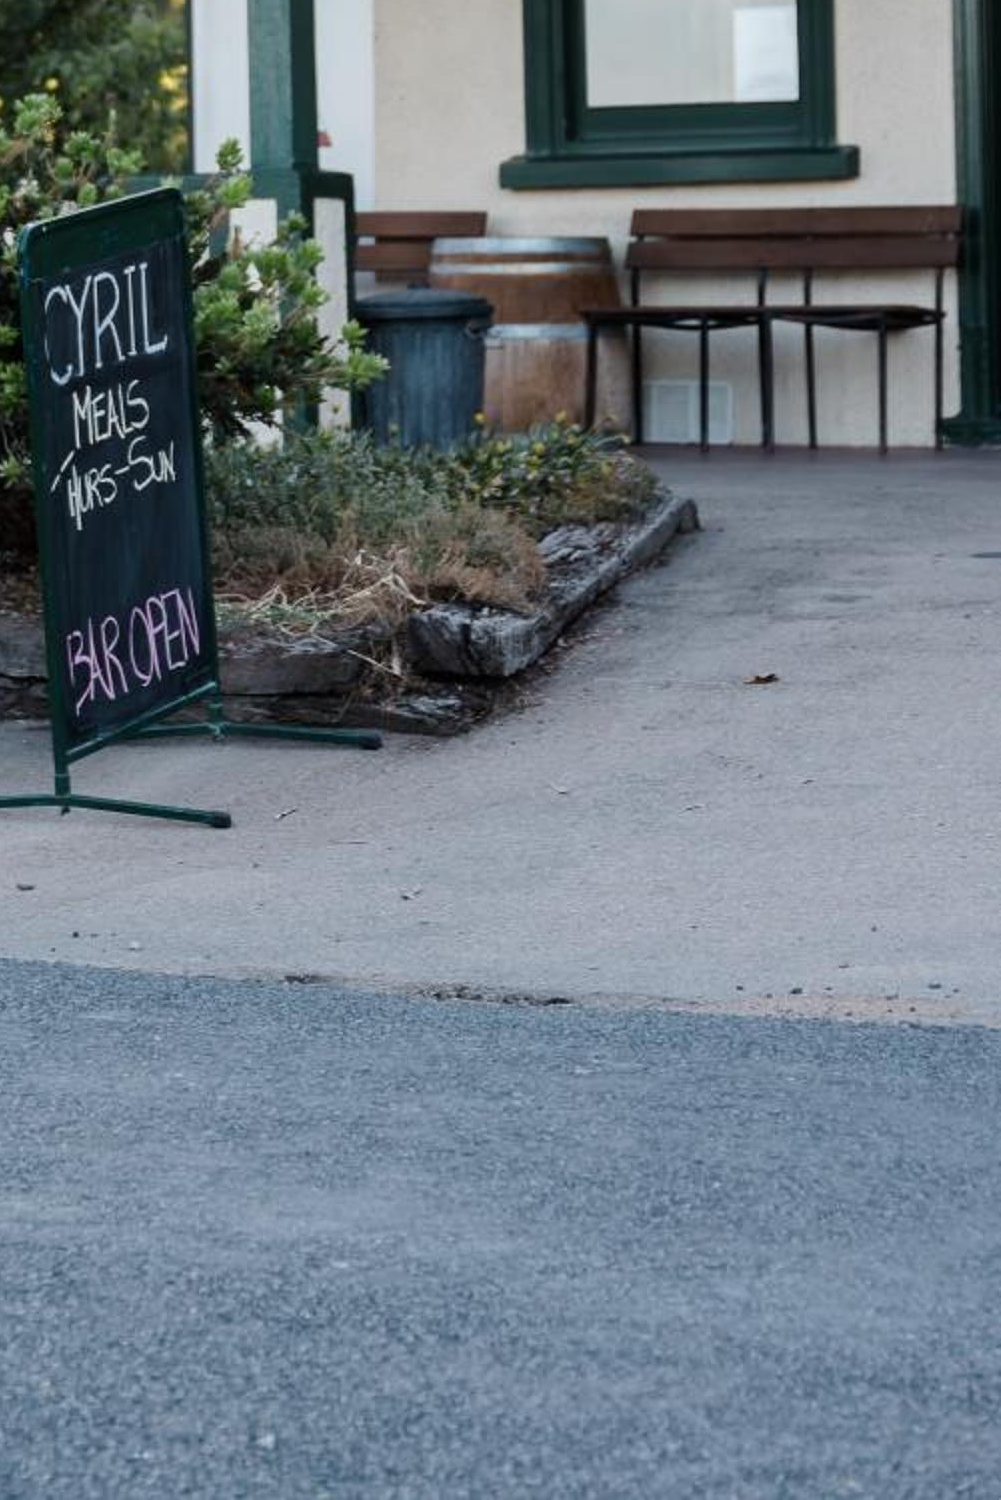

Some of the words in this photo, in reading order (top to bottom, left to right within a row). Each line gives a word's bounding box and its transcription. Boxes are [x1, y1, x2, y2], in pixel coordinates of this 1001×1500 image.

[44, 260, 169, 387] CYRIL
[72, 378, 150, 451] MEALS
[65, 611, 129, 717] BAR
[127, 586, 201, 690] OPEN
